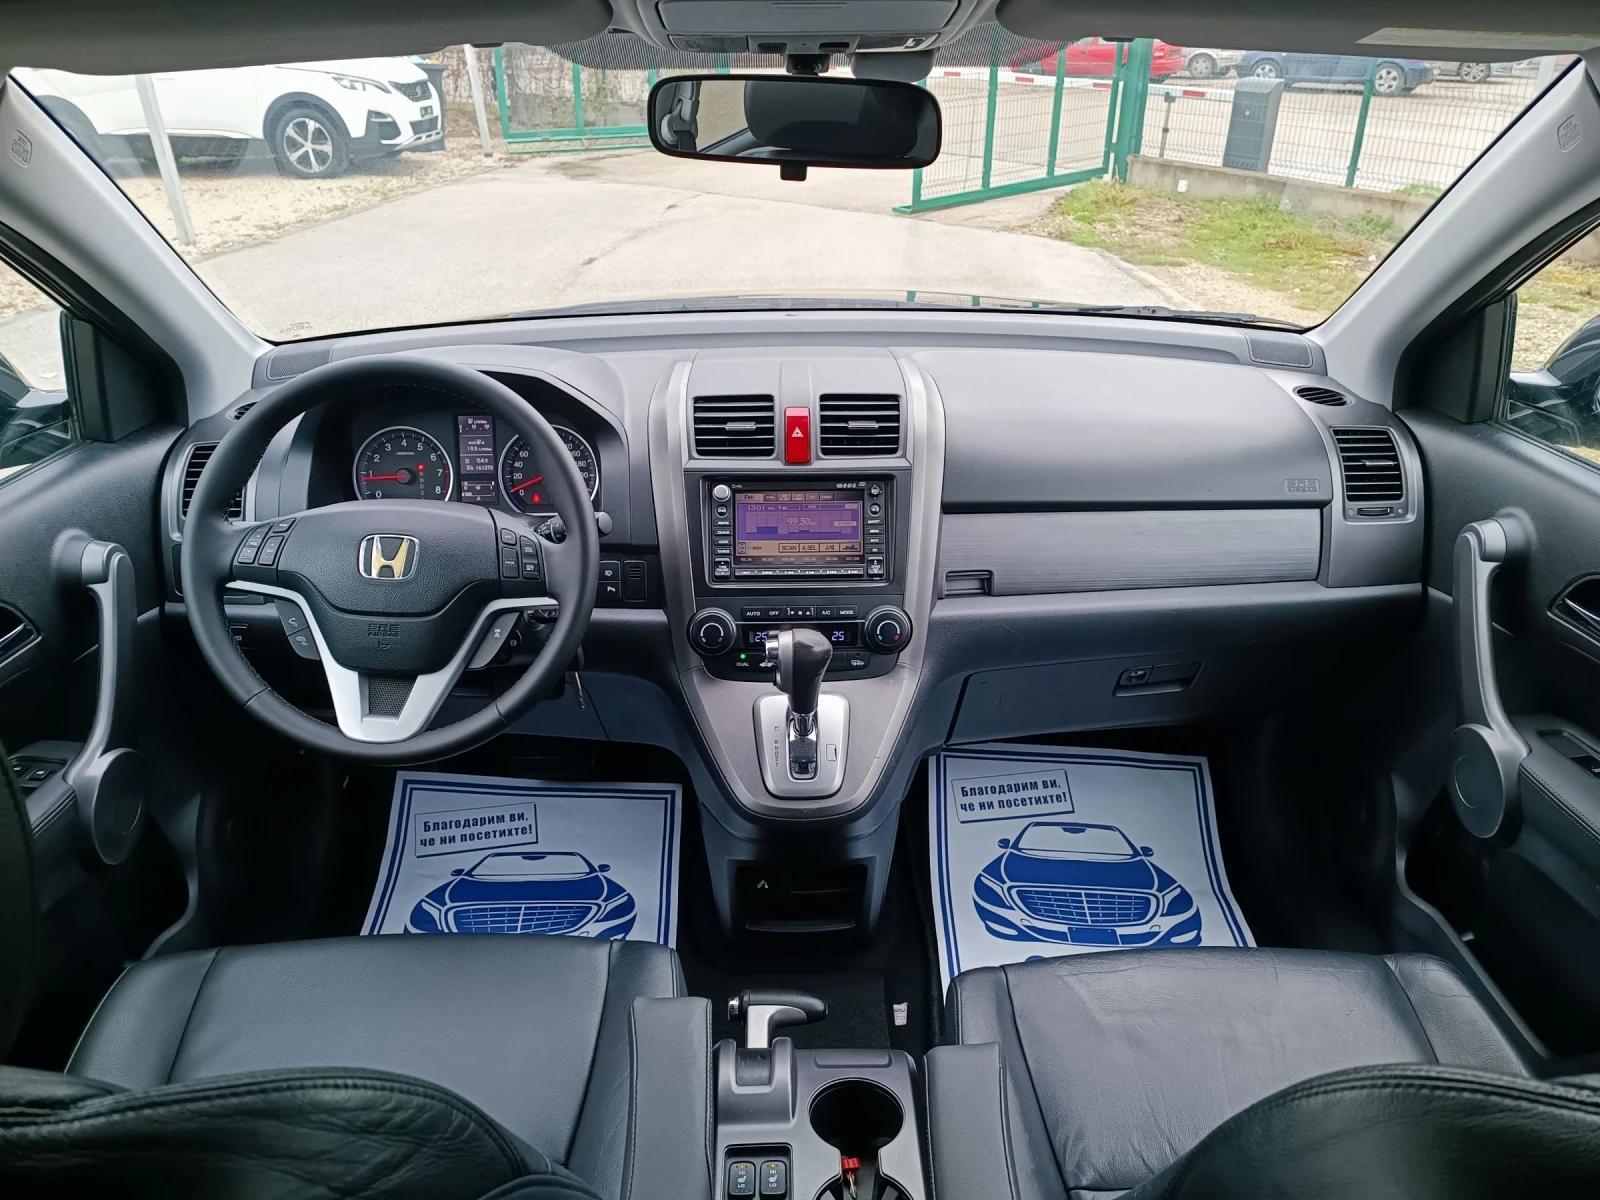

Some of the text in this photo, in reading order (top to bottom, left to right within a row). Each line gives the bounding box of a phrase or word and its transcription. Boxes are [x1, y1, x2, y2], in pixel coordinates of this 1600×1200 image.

[401, 439, 407, 447] 4
[755, 632, 768, 642] 25
[832, 631, 844, 641] 25
[961, 779, 1061, 797] Благодарим ви,
[960, 792, 1067, 812] че ни посетихте!
[424, 812, 528, 832] Благодарим ви,
[420, 824, 533, 847] че ни посетихте!
